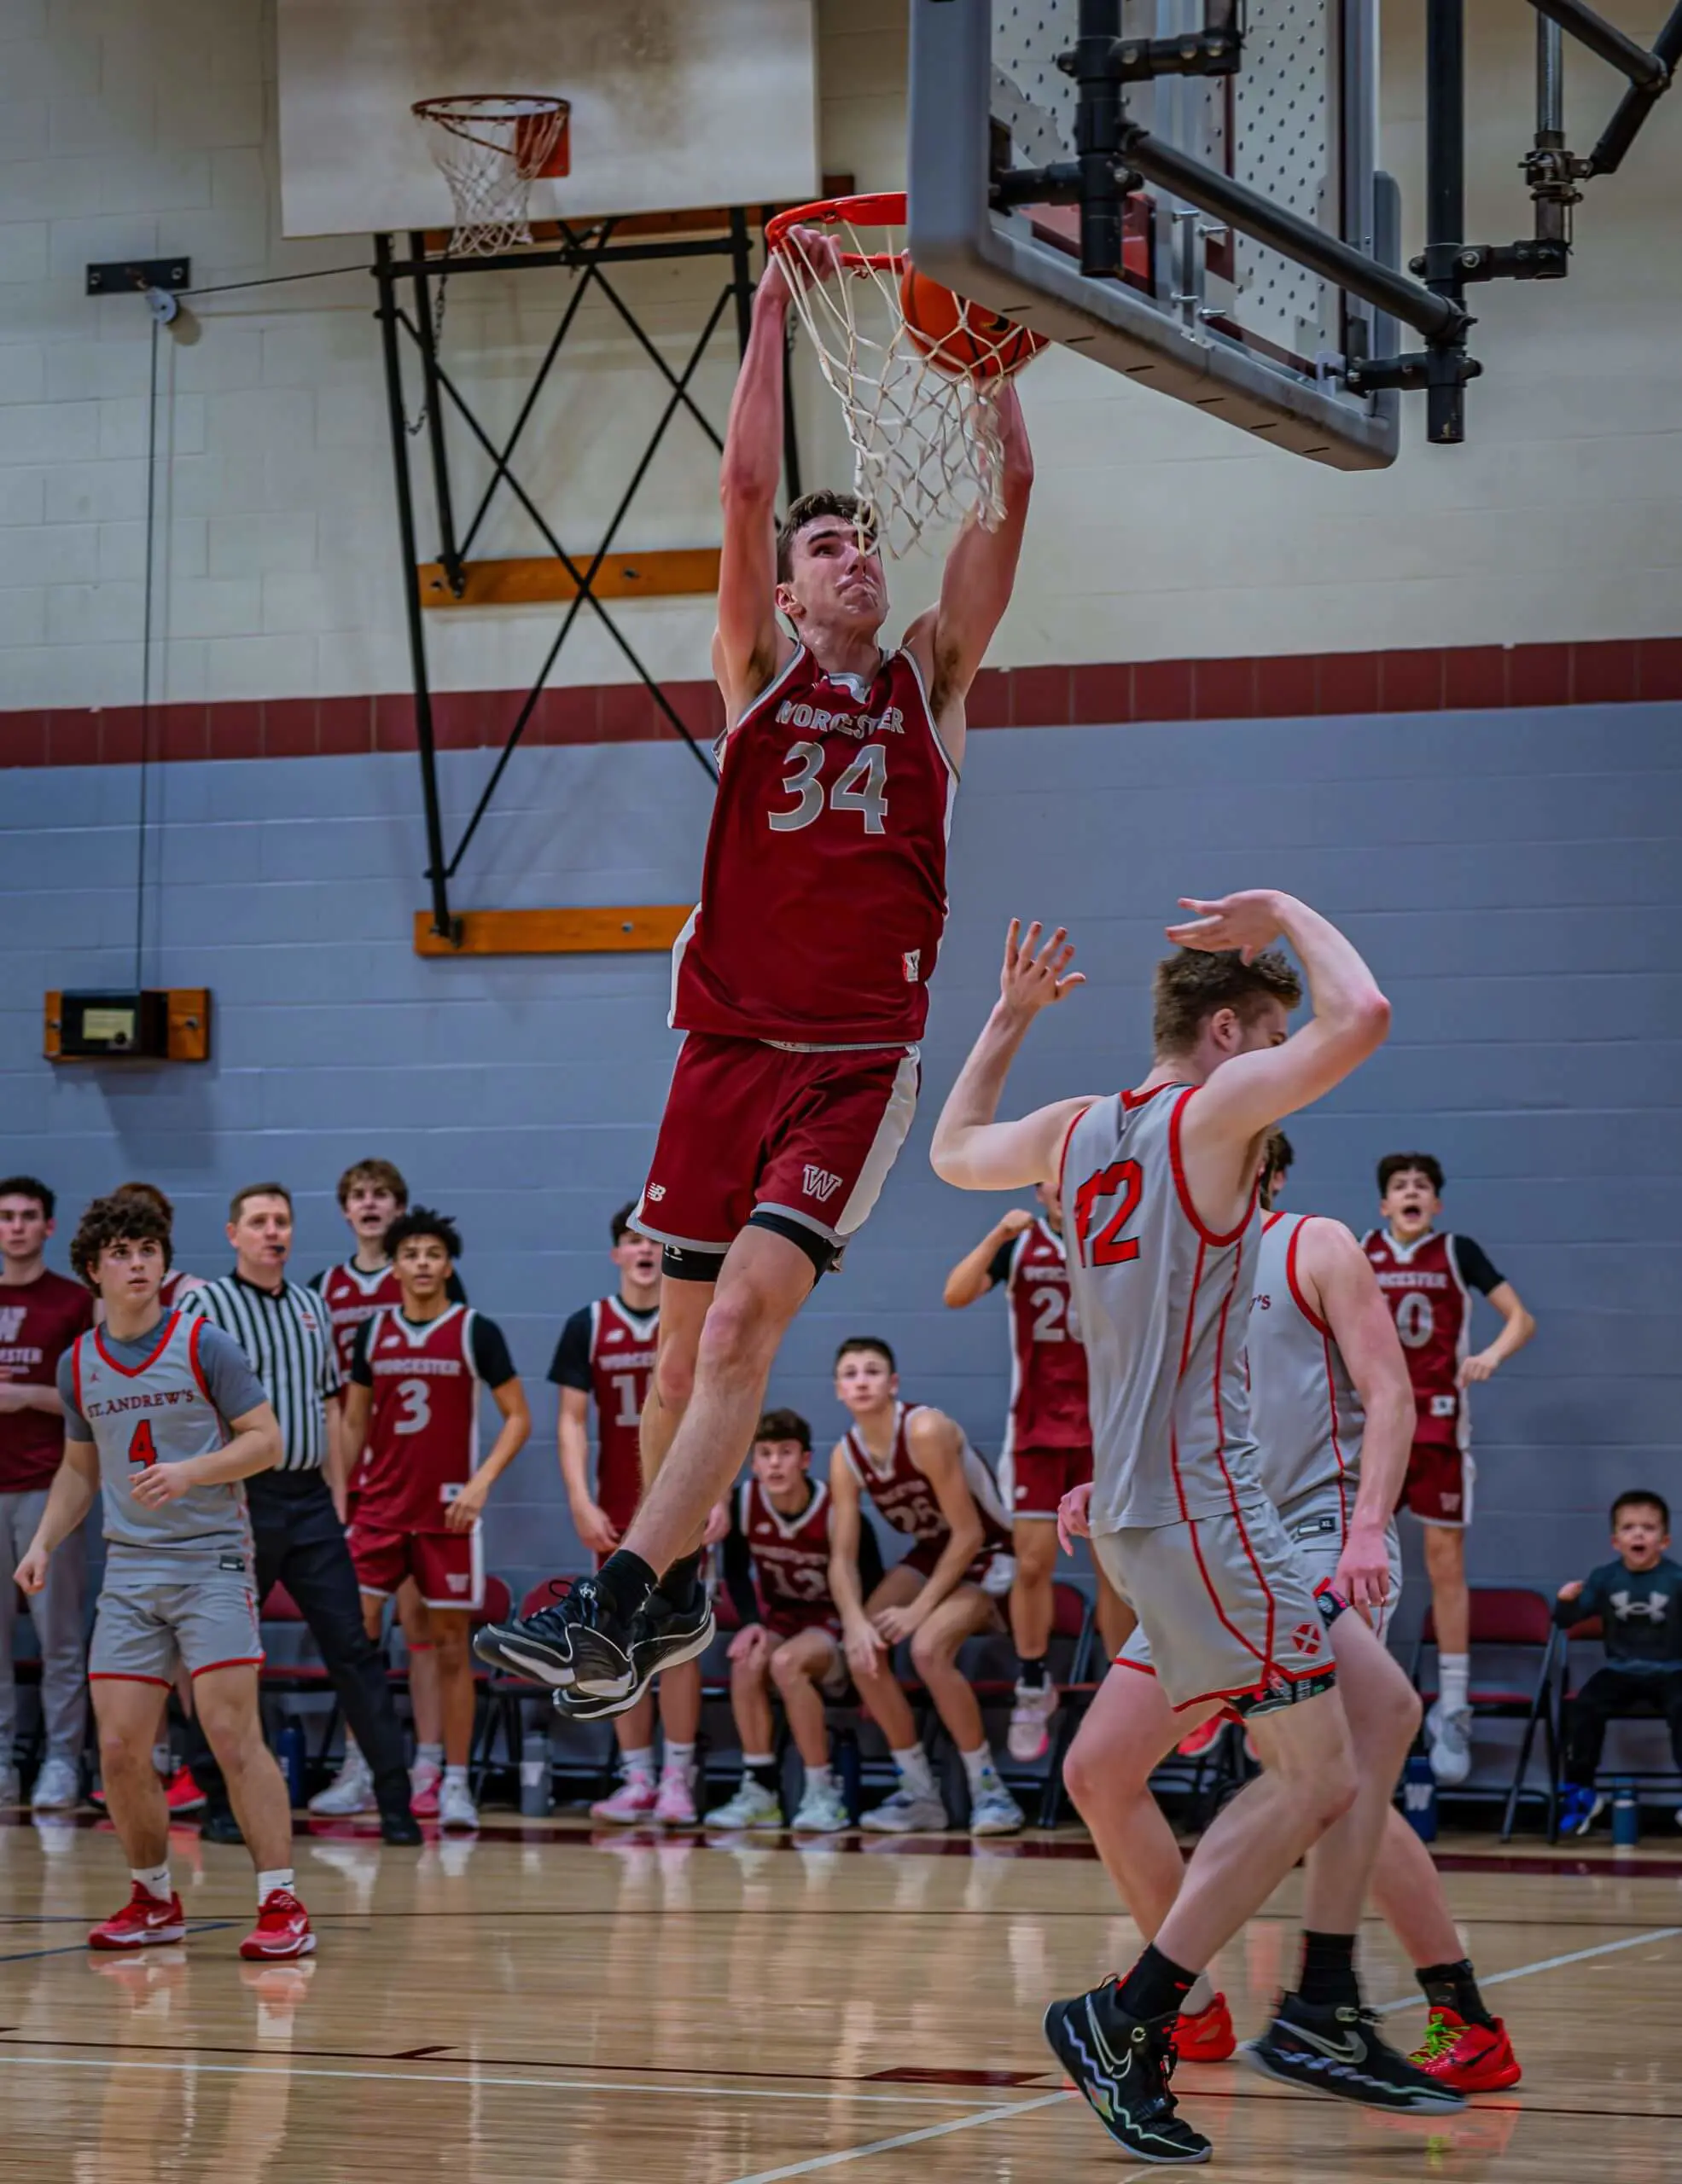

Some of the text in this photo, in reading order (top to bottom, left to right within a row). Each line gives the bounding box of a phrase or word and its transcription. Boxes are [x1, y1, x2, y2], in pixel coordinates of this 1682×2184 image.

[775, 700, 905, 739] WORCSTER
[767, 741, 888, 834] 34
[802, 1164, 843, 1202] W
[394, 1379, 431, 1434] 3
[128, 1419, 158, 1469] 4
[1405, 1782, 1434, 1811] W
